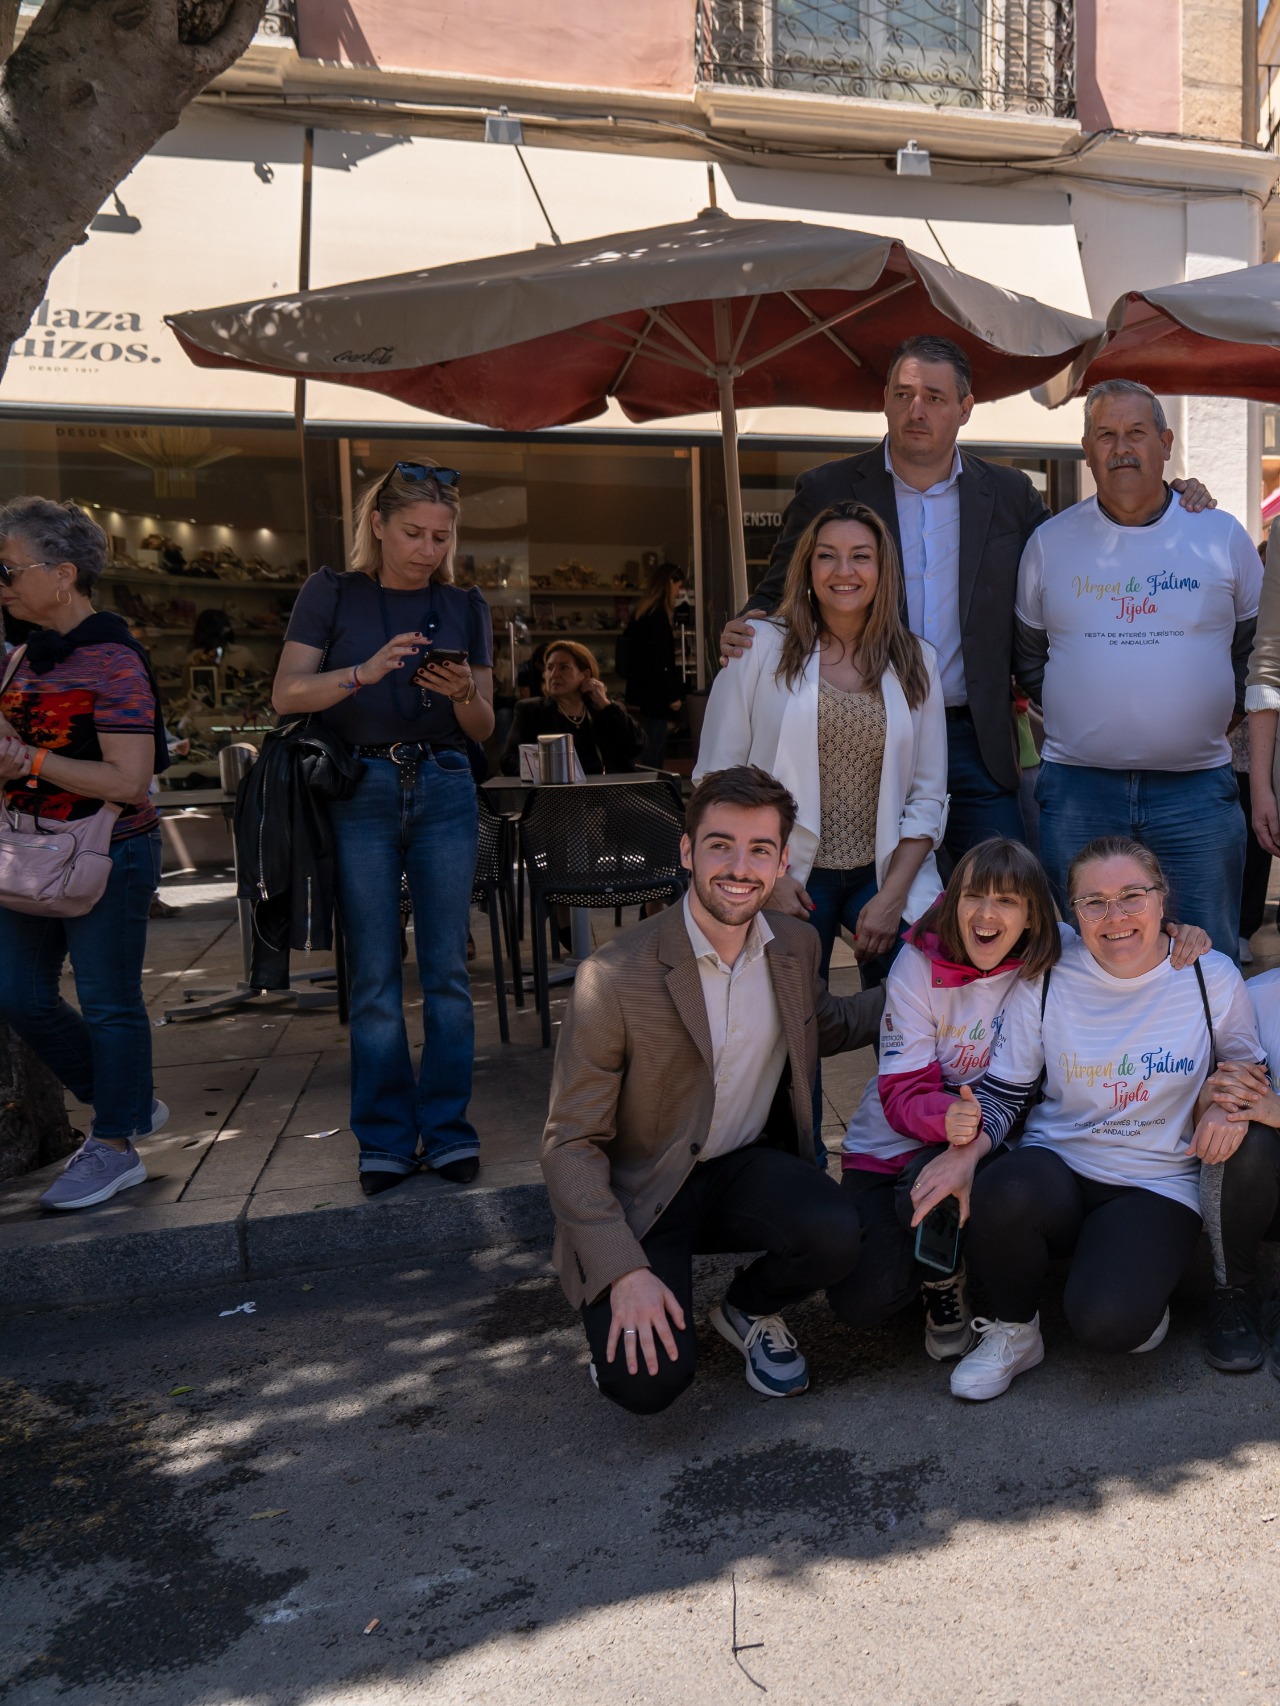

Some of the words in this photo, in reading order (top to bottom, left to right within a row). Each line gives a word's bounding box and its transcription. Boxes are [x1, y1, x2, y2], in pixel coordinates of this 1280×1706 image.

[37, 299, 143, 332] laza
[9, 330, 161, 364] uizos.
[29, 365, 69, 373] DESDE
[56, 427, 107, 438] DESDE
[743, 511, 782, 528] ENSTO
[1072, 575, 1121, 600] Virgen
[1126, 576, 1142, 593] de
[1146, 570, 1200, 596] Fátima
[1111, 596, 1158, 623] Tíjola
[969, 1020, 987, 1040] de
[1059, 1052, 1113, 1087] Virgen
[1118, 1054, 1136, 1076] de
[1141, 1047, 1195, 1080] Fátima
[1103, 1081, 1150, 1112] Tíjola
